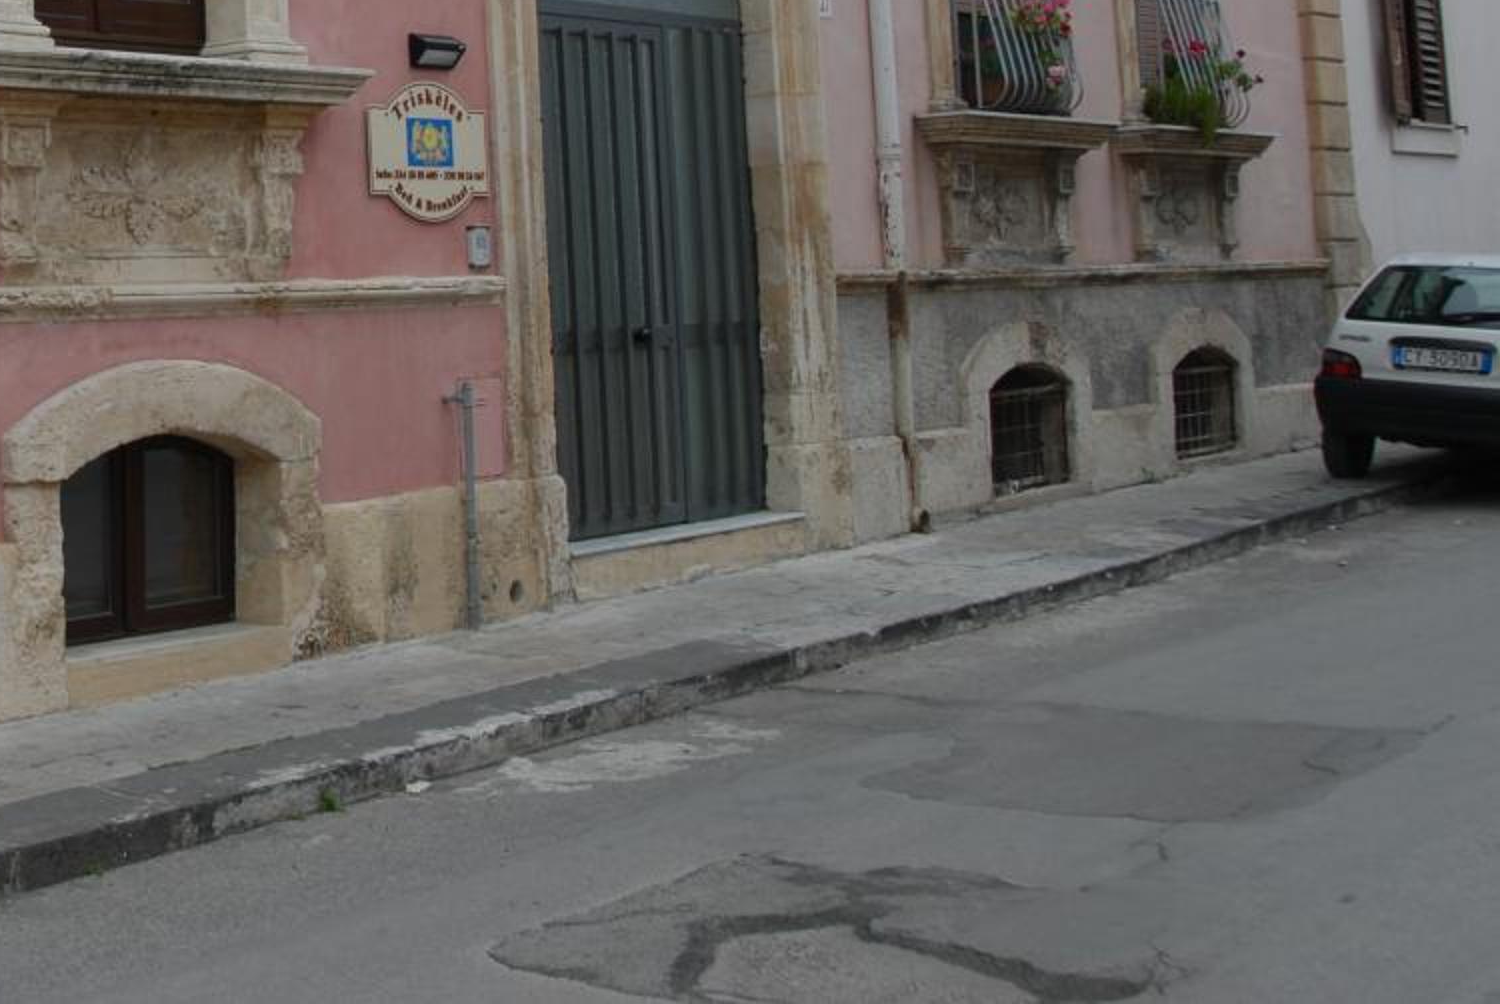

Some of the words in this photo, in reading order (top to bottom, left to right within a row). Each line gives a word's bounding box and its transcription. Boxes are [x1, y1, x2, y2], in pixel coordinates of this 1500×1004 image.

[395, 182, 413, 204] Bed
[415, 198, 423, 209] &
[426, 186, 468, 212] Breakfast
